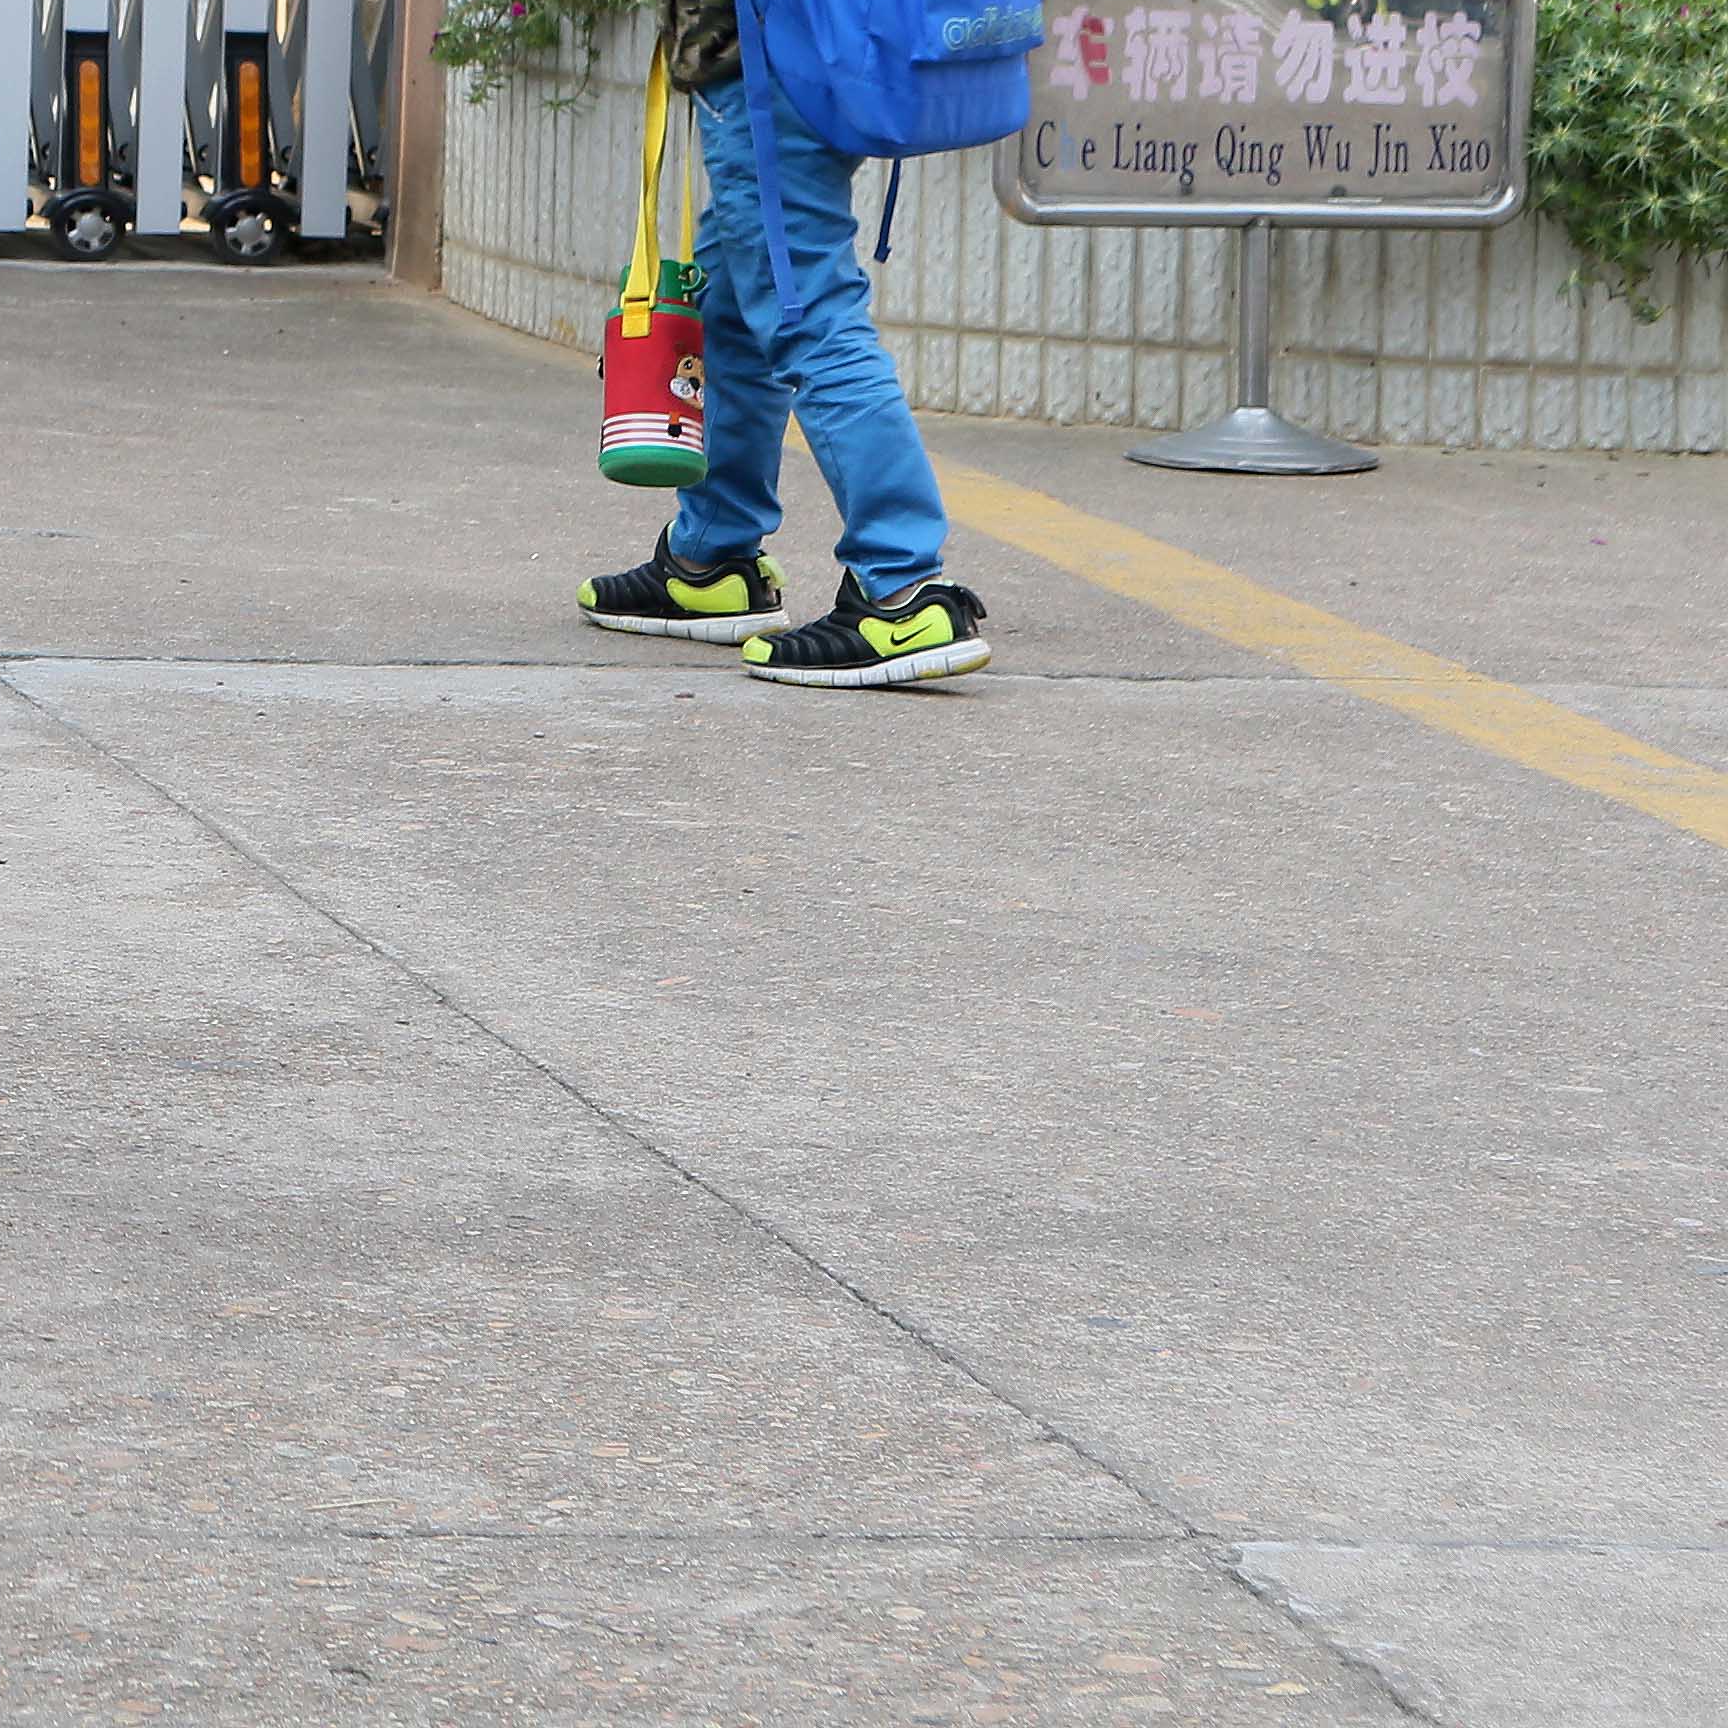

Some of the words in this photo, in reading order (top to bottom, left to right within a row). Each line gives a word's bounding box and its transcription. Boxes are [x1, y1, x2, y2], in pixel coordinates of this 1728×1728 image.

[1049, 6, 1483, 108] 车辆请勿进校
[1112, 122, 1199, 186] Liang
[1214, 124, 1284, 186] Qing
[1303, 123, 1351, 173] Wu
[1368, 122, 1410, 178] Jin
[1428, 122, 1491, 174] Xiao
